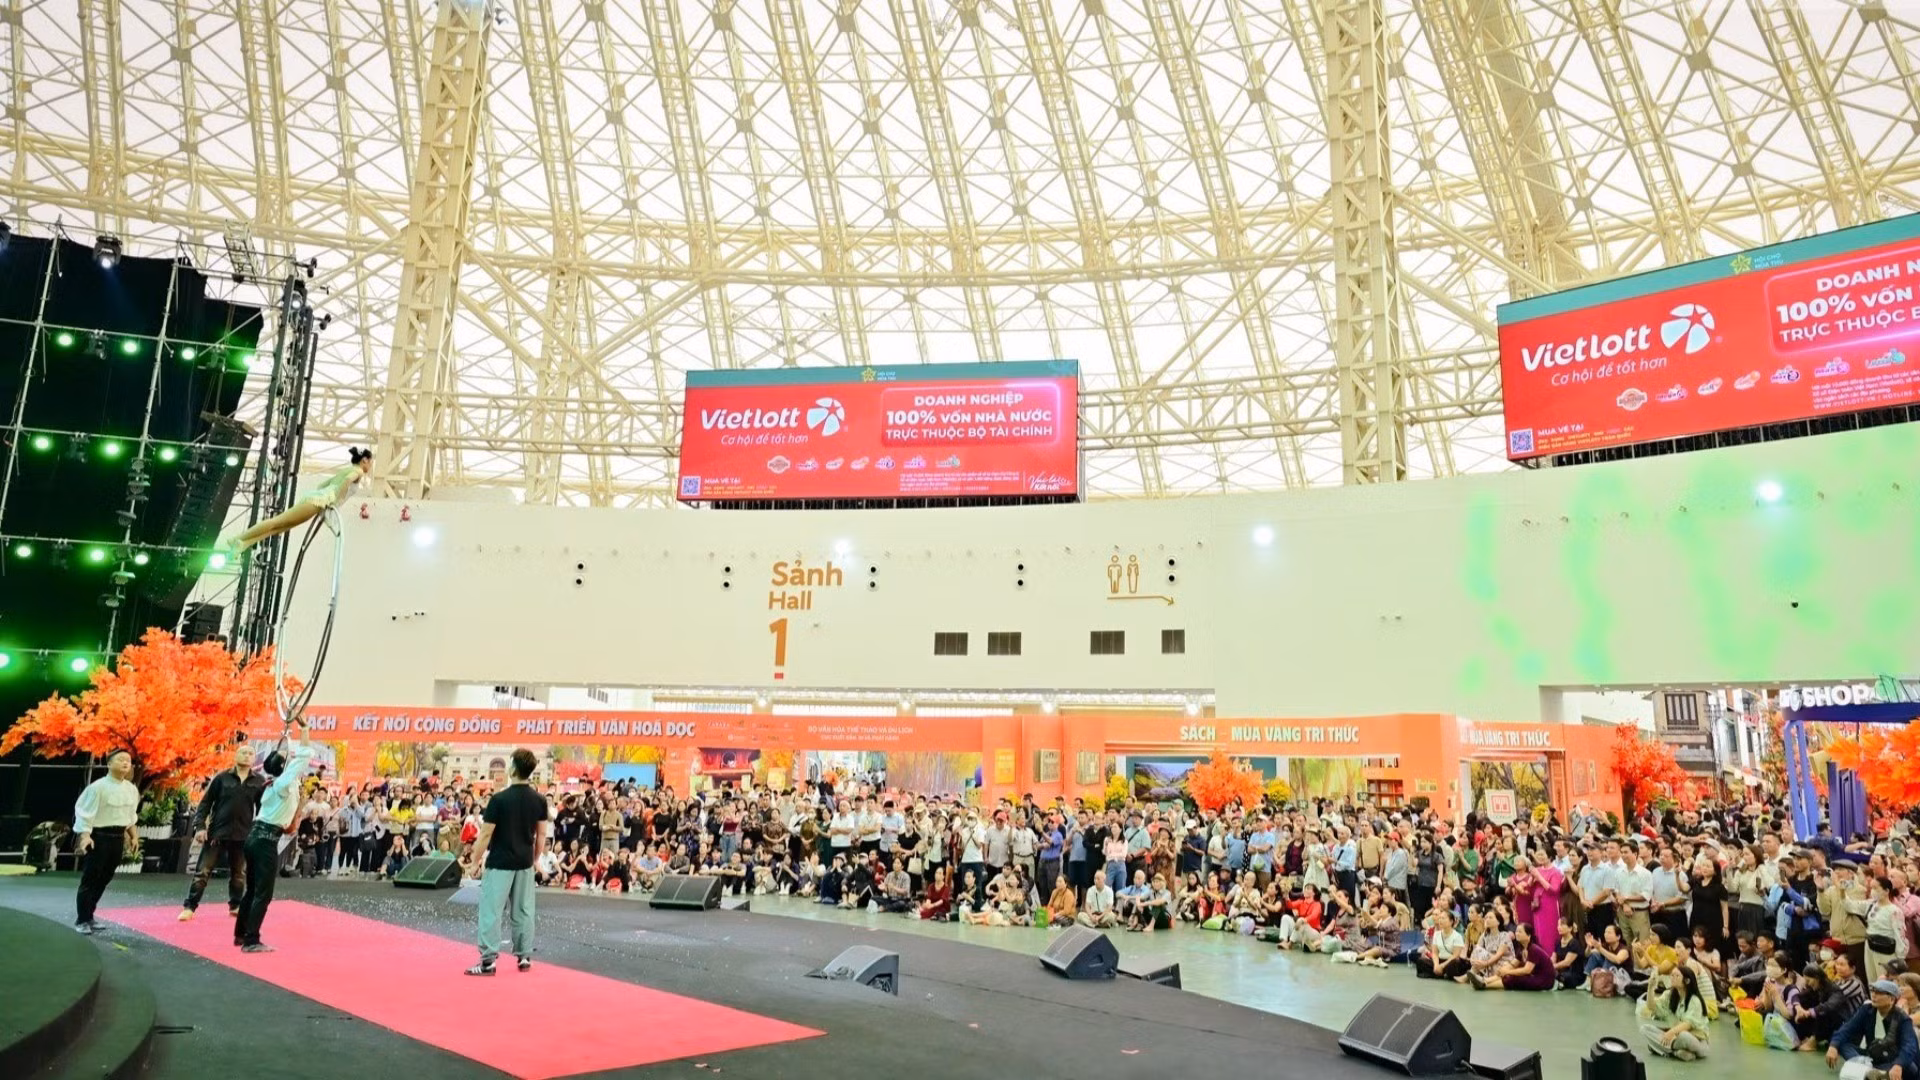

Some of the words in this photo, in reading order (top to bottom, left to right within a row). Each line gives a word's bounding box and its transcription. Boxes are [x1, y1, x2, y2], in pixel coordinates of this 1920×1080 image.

[1816, 263, 1900, 293] DOANH
[1776, 293, 1857, 324] 100%
[1861, 284, 1913, 308] VỐN
[1779, 322, 1831, 343] TRỰC
[1835, 309, 1905, 333] THUỘC
[1520, 324, 1651, 372] Vietlott
[1551, 373, 1569, 386] Cơ
[1572, 367, 1593, 384] hội
[1616, 359, 1636, 375] tốt
[1640, 356, 1668, 371] hơn
[914, 395, 966, 407] DOANH
[970, 390, 1024, 407] NGHIỆP
[701, 407, 800, 430] Vietlott
[886, 410, 937, 425] 100%
[940, 409, 971, 424] VỐN
[975, 409, 1006, 424] NHÀ
[1010, 408, 1052, 422] NƯỚC
[736, 433, 753, 446] hội
[771, 432, 787, 444] tốt
[788, 433, 809, 443] hơn
[886, 428, 918, 441] TRỰC
[922, 426, 965, 440] THUỘC
[968, 425, 986, 439] BỘ
[990, 424, 1008, 437] TÀI
[1012, 423, 1052, 437] CHÍNH
[771, 559, 843, 587] Sảnh
[768, 590, 812, 610] Hall
[769, 618, 788, 667] 1
[352, 712, 380, 731] KẾT
[383, 713, 410, 732] NỐI
[413, 715, 455, 734] CỘNG
[458, 713, 502, 733] ĐỒNG
[516, 717, 553, 735] PHÁT
[556, 715, 598, 736] TRIỂN
[665, 721, 697, 739] ĐỌC
[1180, 720, 1217, 741] SÁCH
[1231, 723, 1261, 742] MÙA
[1265, 723, 1302, 743] VÀNG
[1327, 723, 1360, 743] THỨC
[1521, 728, 1551, 747] THỨC
